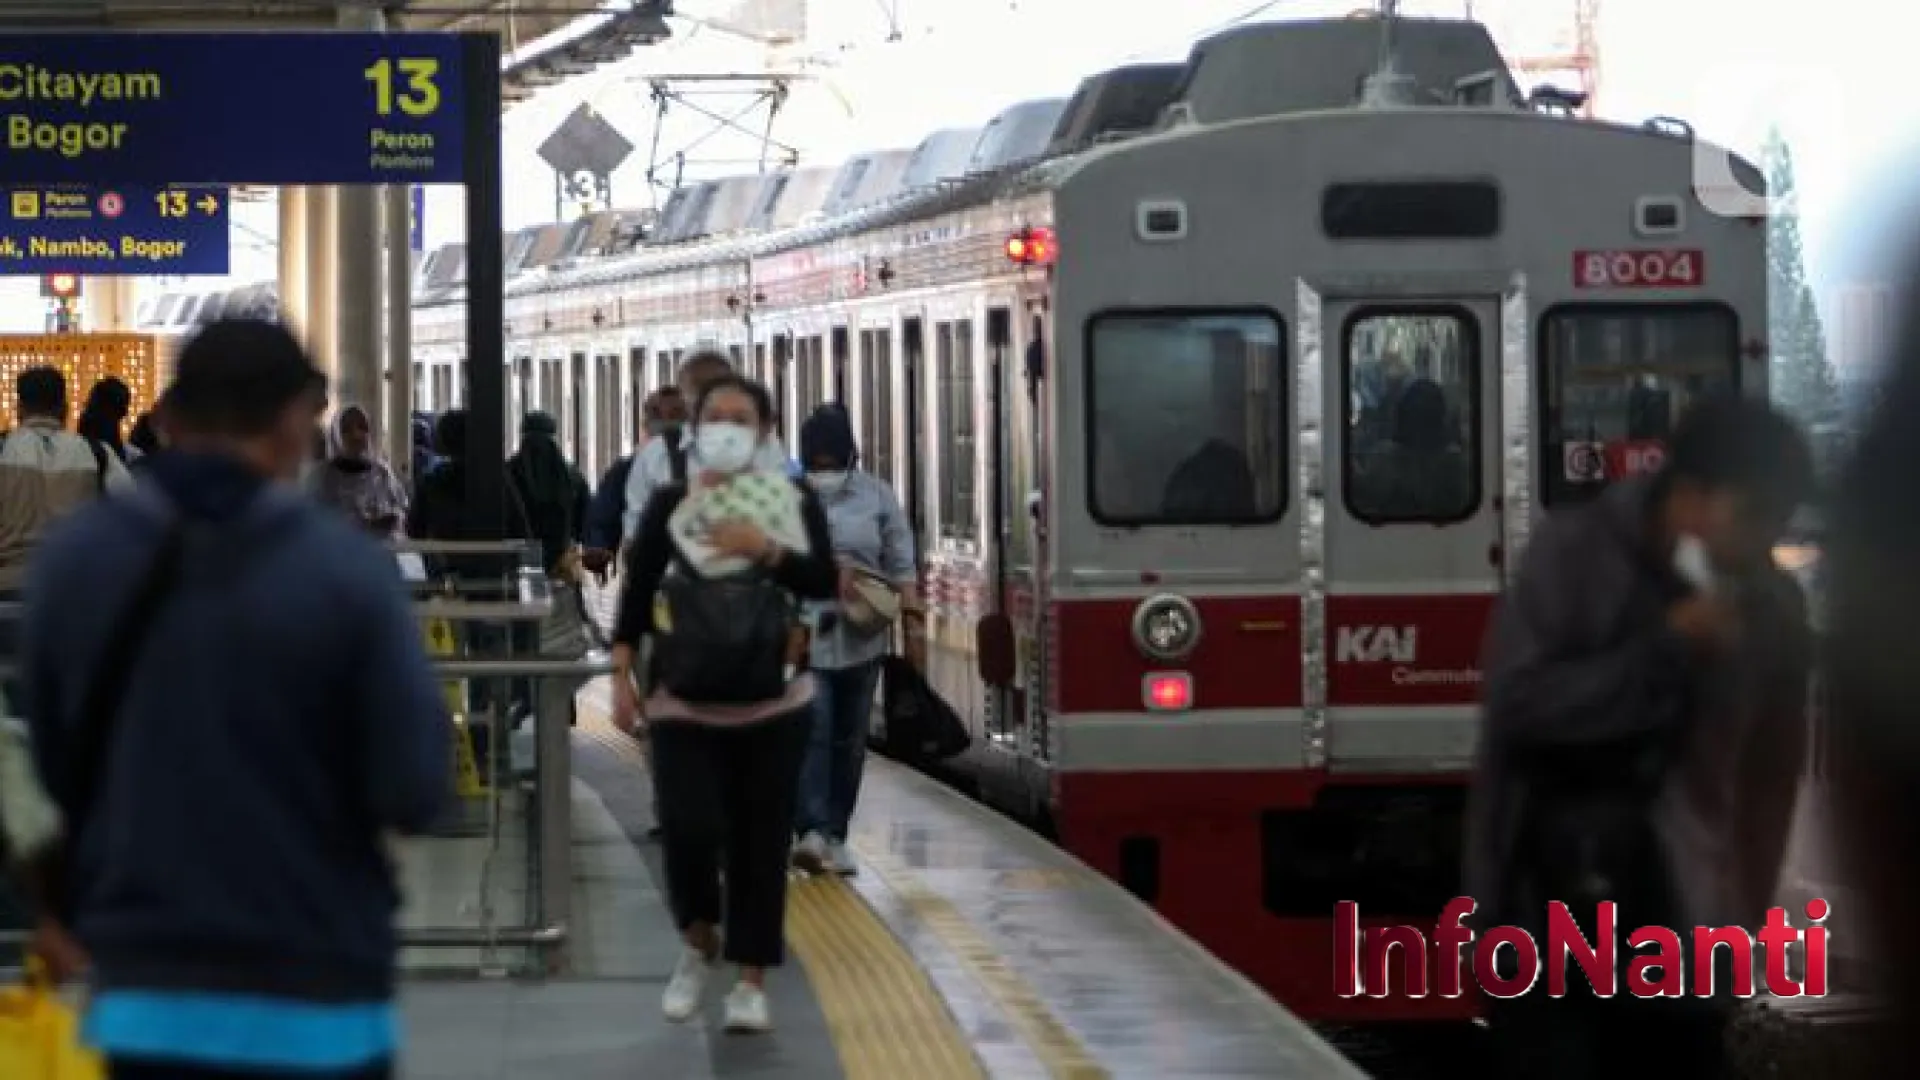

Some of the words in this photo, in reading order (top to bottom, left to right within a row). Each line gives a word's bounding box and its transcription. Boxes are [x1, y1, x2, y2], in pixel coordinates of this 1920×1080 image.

[0, 63, 161, 106] Citayam
[364, 57, 440, 117] 13
[8, 114, 127, 158] Bogor
[370, 128, 435, 149] Peron
[156, 191, 188, 217] 13
[29, 235, 114, 260] Nambo,
[120, 235, 186, 262] Bogor
[1583, 253, 1694, 284] 8004
[1337, 626, 1417, 662] KAI
